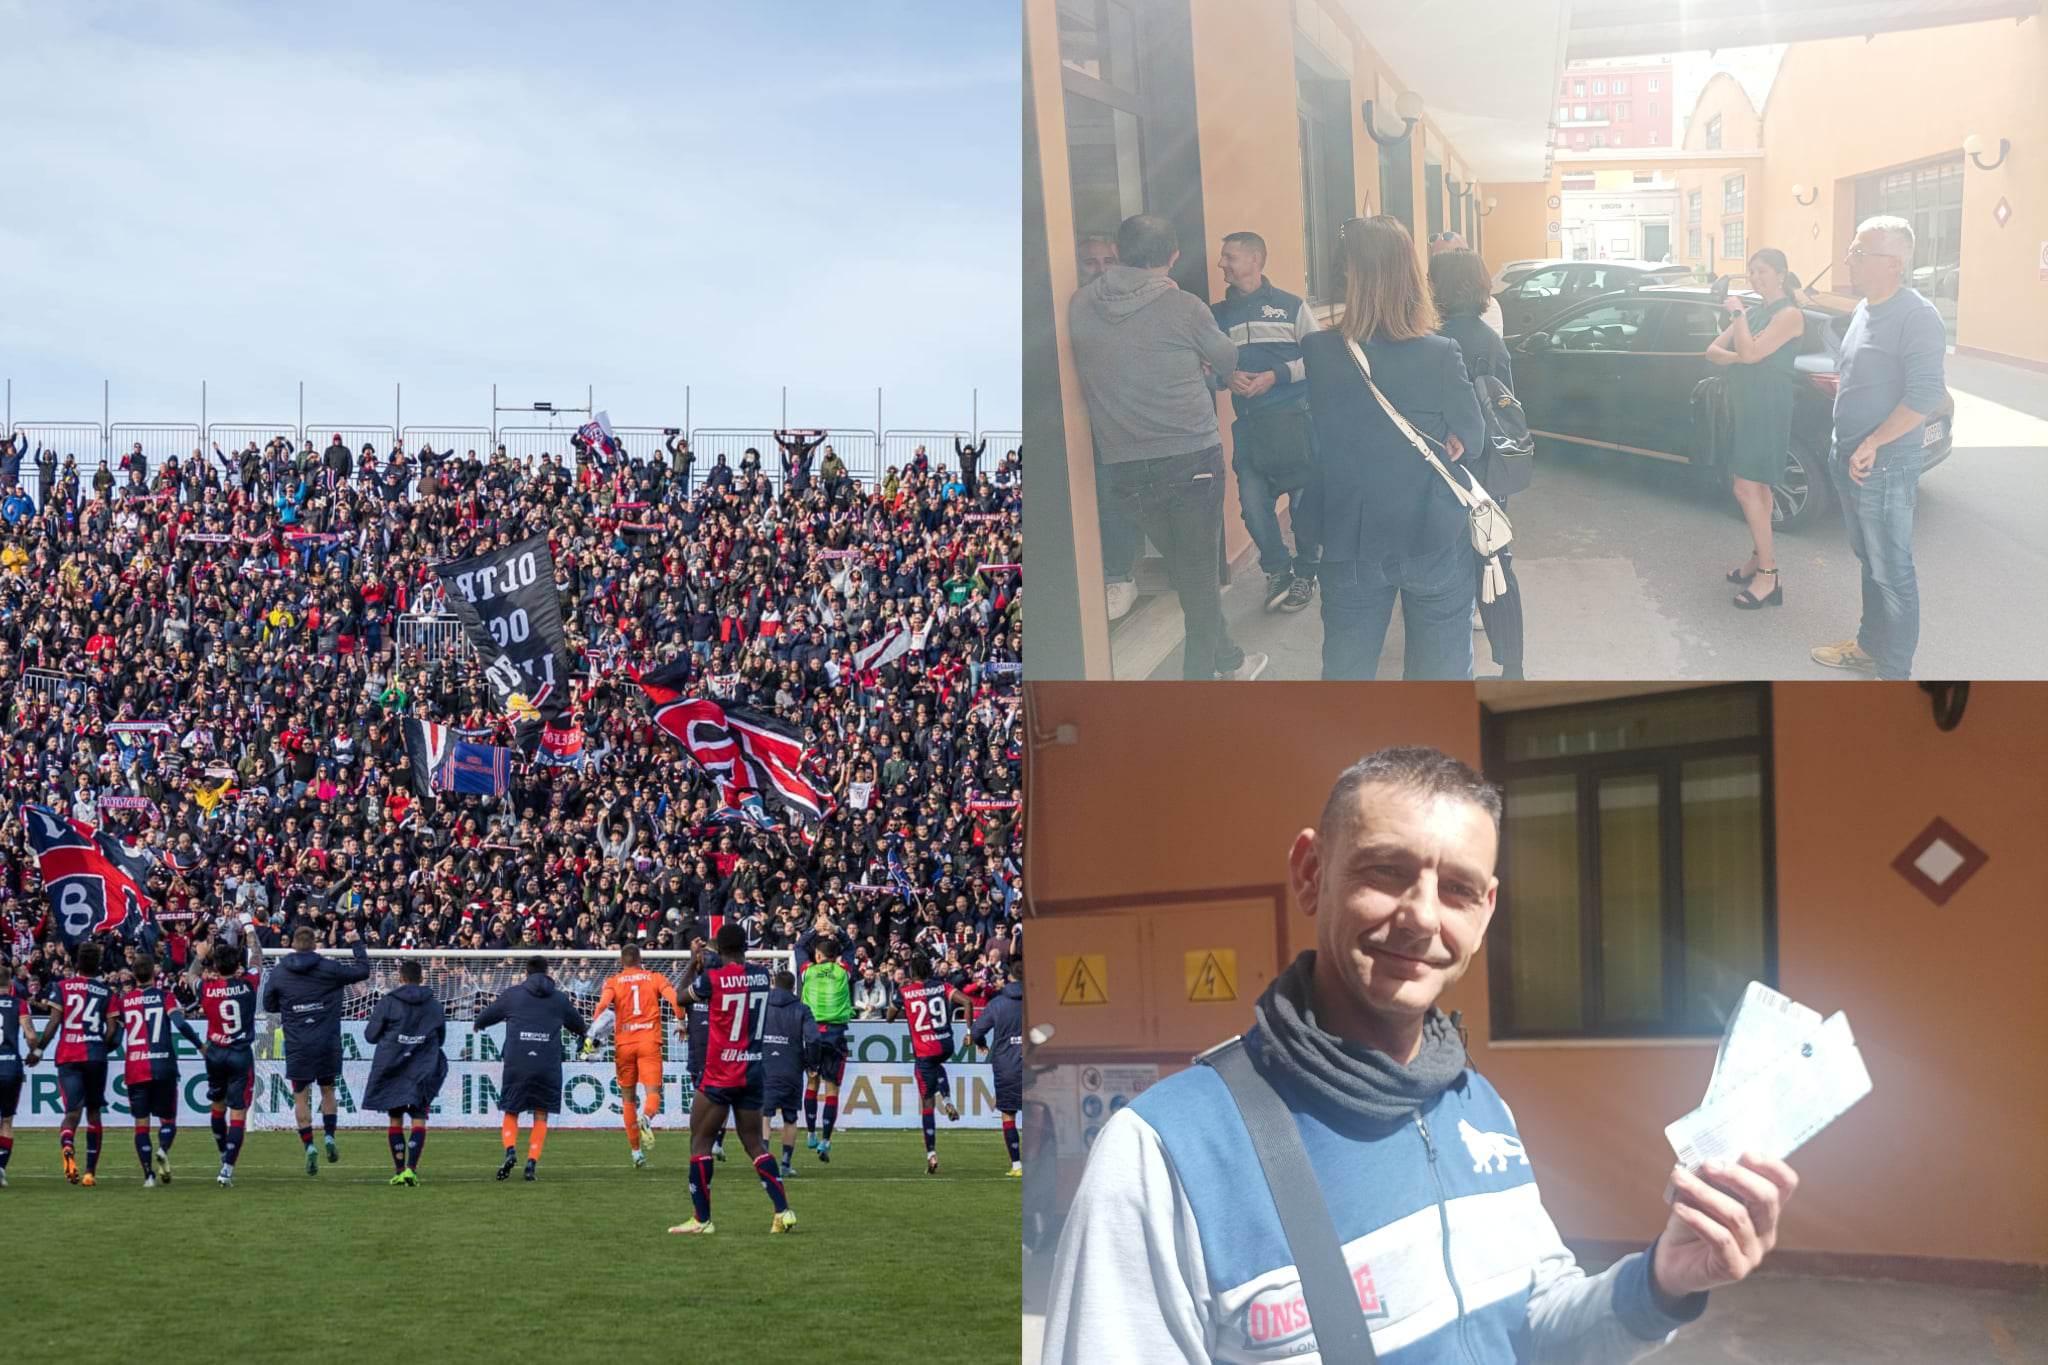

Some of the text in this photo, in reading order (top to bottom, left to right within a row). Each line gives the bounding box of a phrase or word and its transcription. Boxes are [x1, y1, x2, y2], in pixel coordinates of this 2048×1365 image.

[206, 984, 250, 998] LAPADULA
[720, 974, 768, 988] LUVUMBO
[65, 994, 100, 1033] 24
[218, 999, 243, 1035] 9
[630, 985, 643, 1016] 1
[721, 991, 769, 1042] 77
[910, 996, 948, 1032] 29
[124, 1007, 164, 1046] 27
